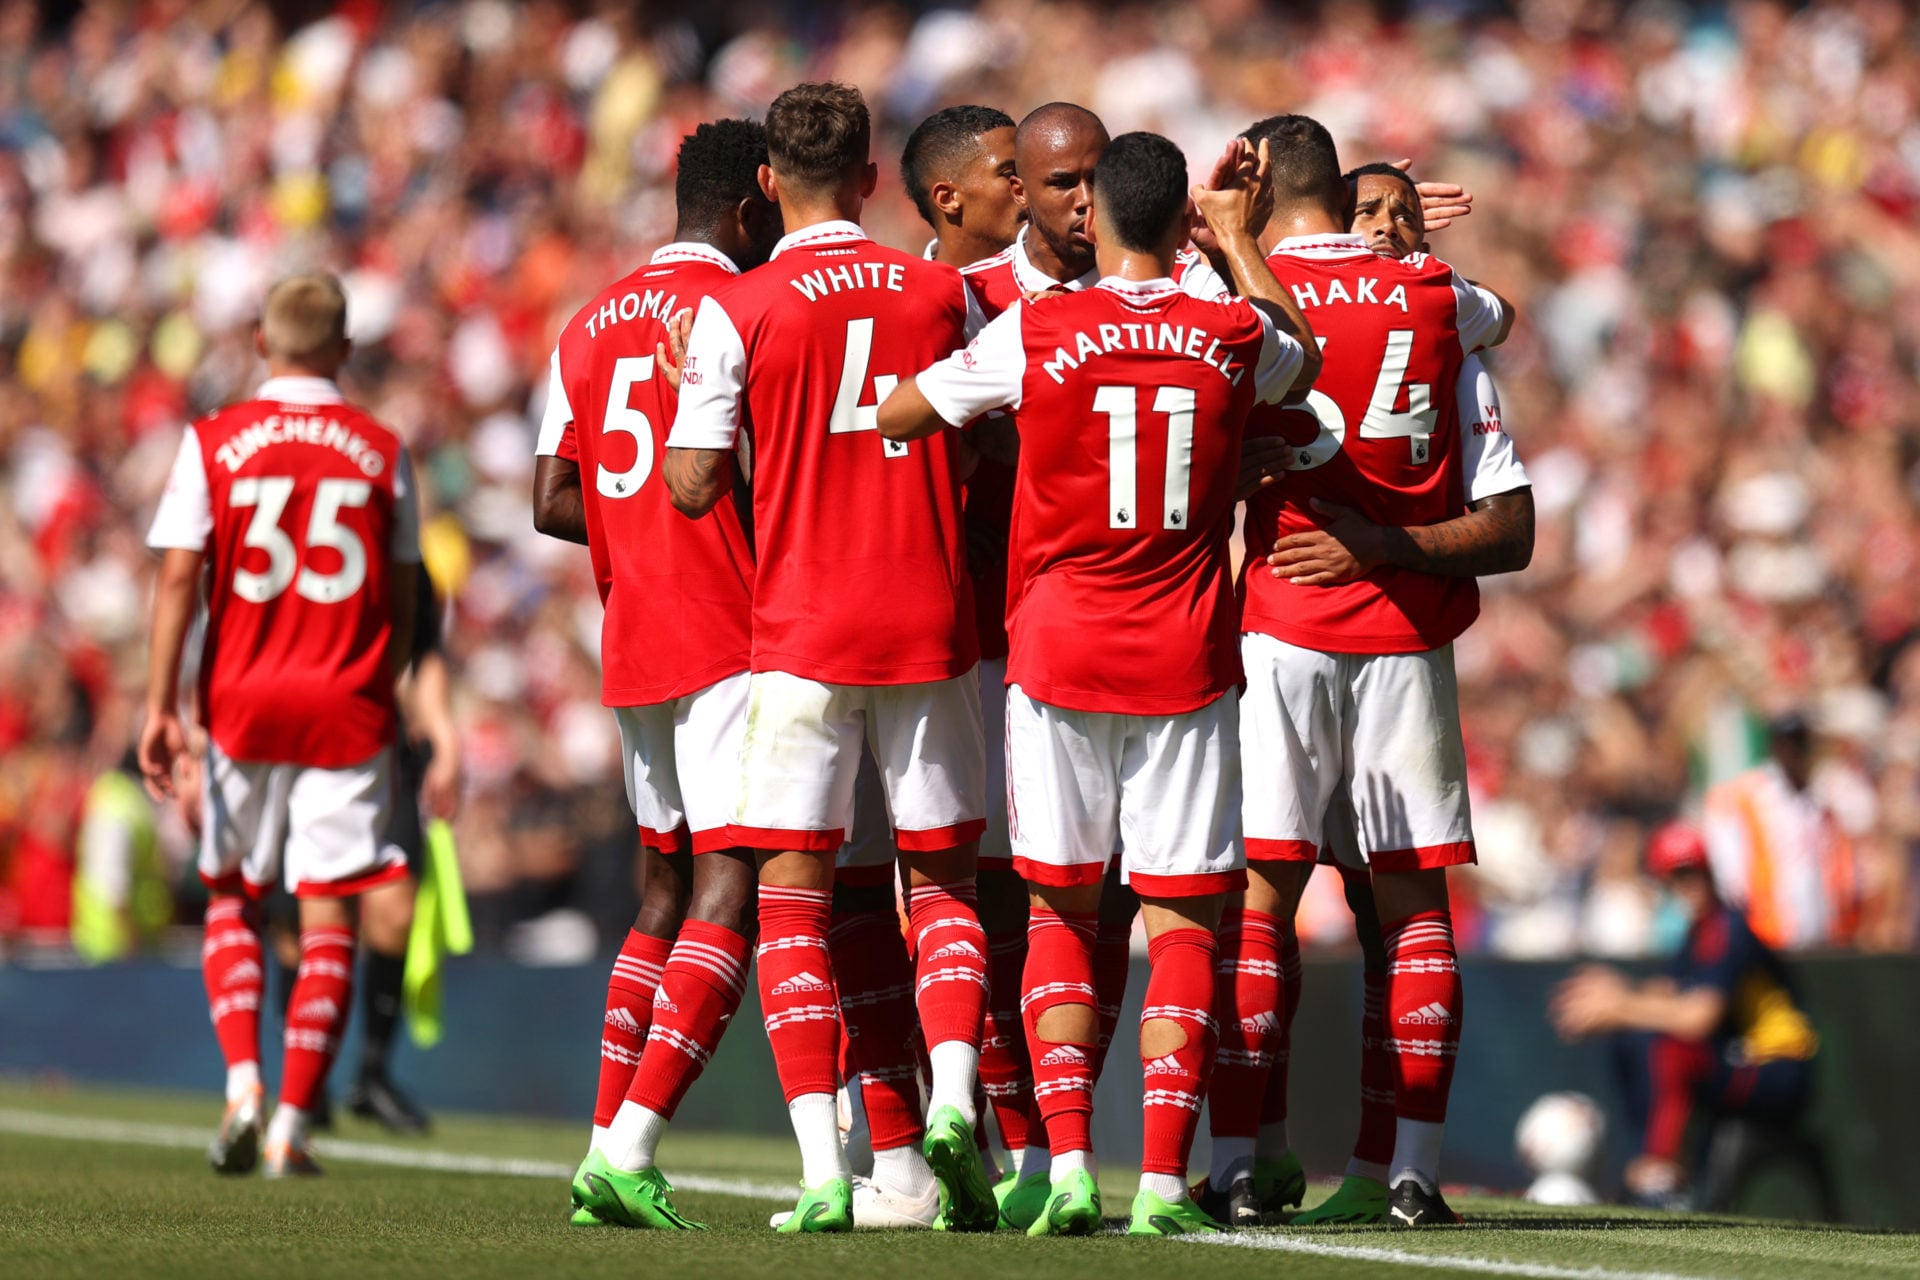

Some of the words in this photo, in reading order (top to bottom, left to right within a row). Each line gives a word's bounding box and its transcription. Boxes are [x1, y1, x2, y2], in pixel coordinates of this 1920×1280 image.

[790, 262, 905, 302] WHITE
[1291, 276, 1408, 312] HAKA
[1043, 323, 1245, 387] MARTINELLI
[829, 317, 909, 459] 4
[214, 415, 385, 478] ZINCHENKO
[596, 353, 655, 499] 5
[1092, 385, 1195, 531] 11
[229, 475, 372, 604] 35
[928, 949, 987, 965] adidas
[771, 983, 832, 996] adidas
